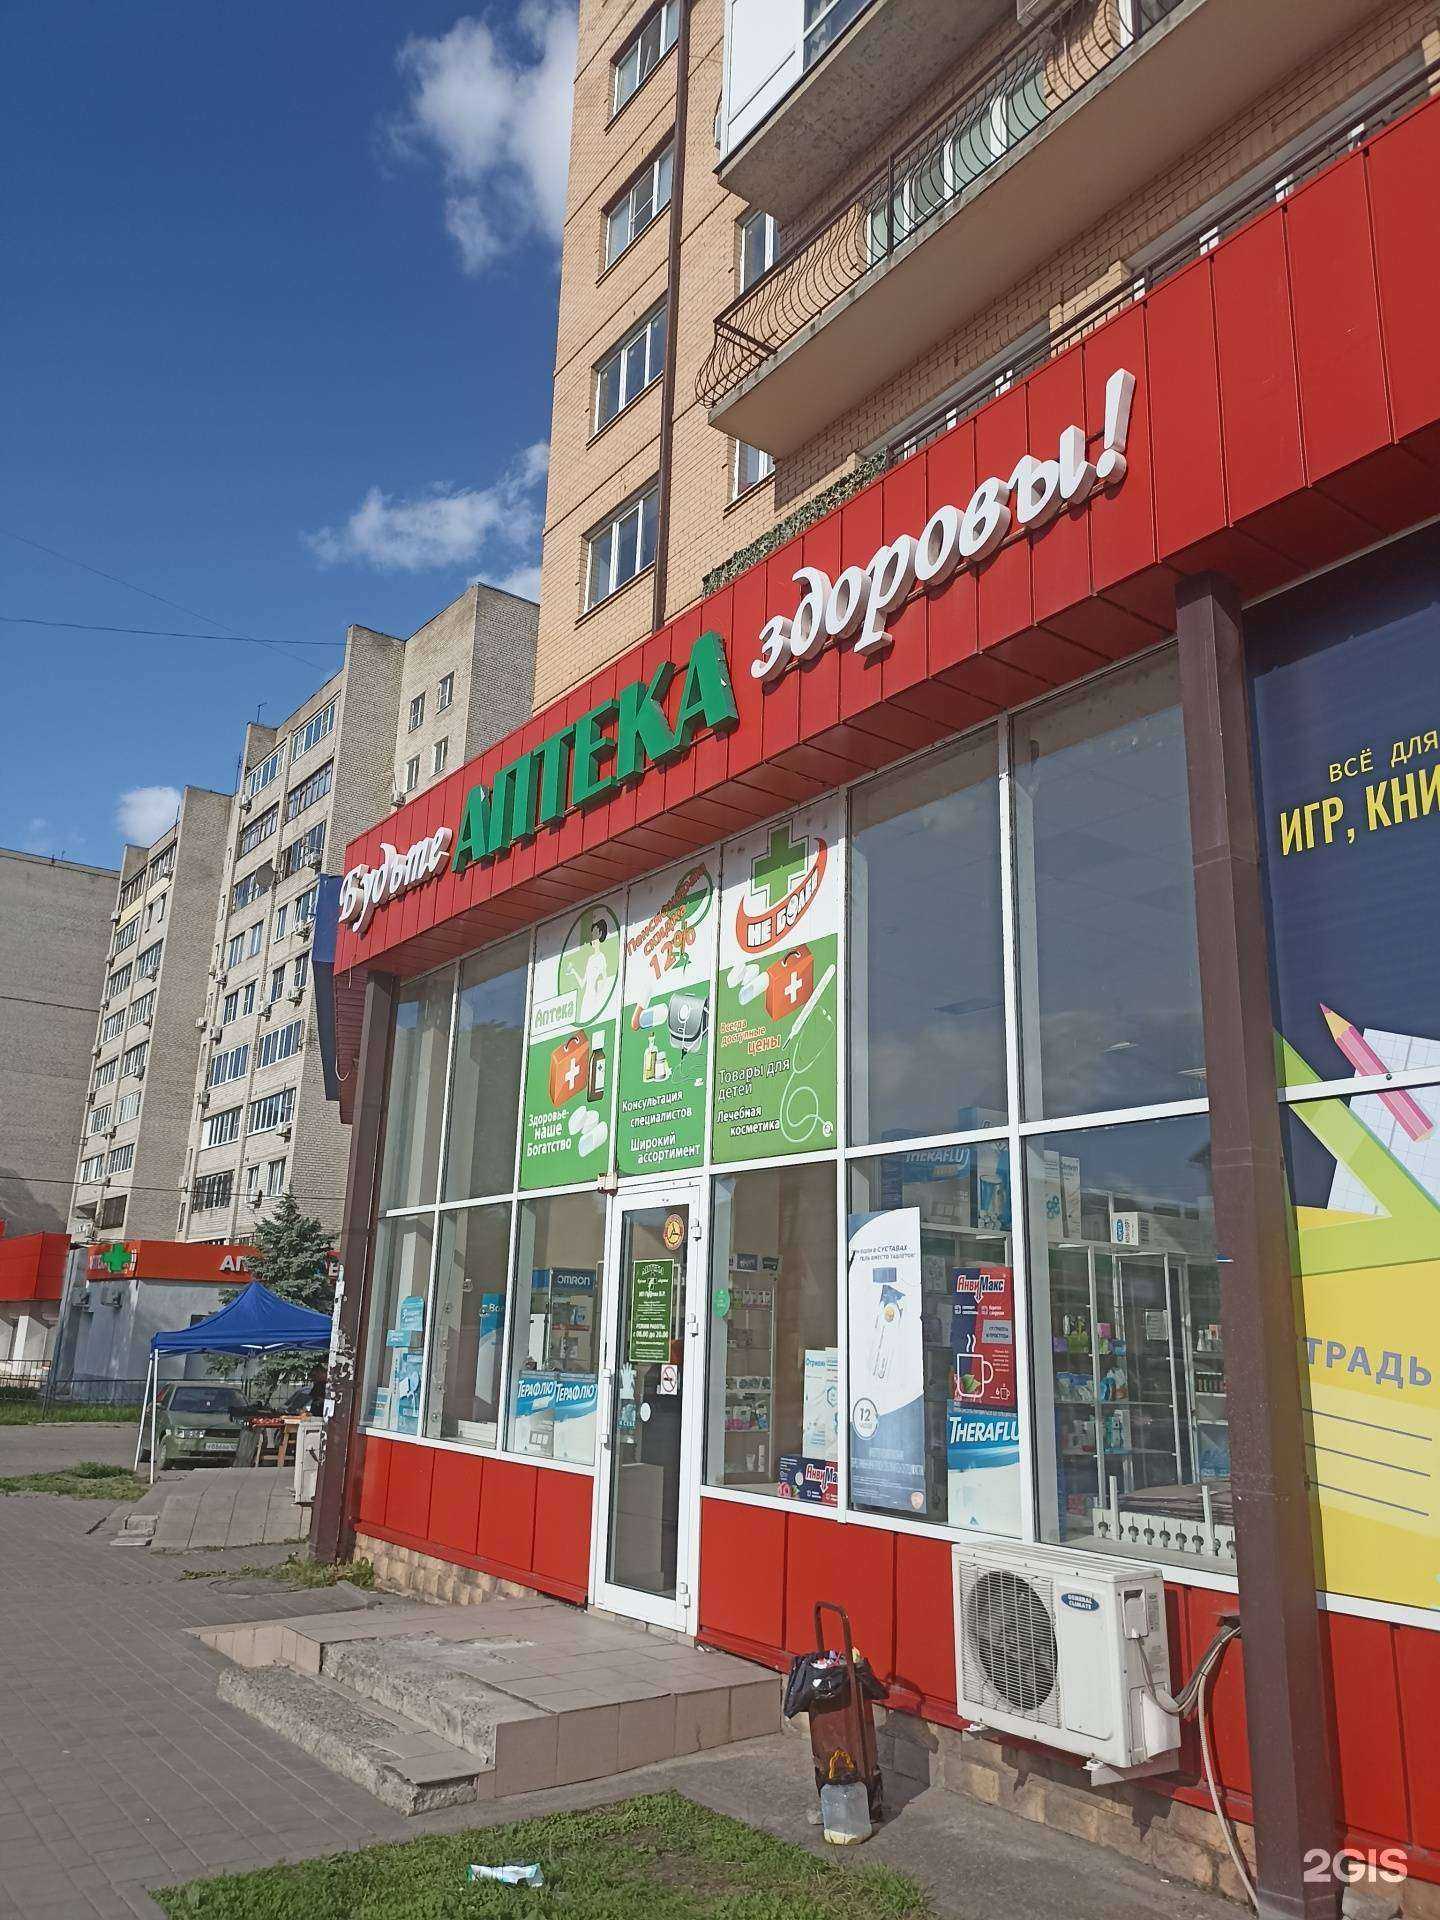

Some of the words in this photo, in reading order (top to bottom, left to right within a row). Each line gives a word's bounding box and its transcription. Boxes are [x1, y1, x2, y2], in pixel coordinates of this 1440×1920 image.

[339, 827, 452, 935] Будьте
[452, 630, 739, 873] АПТЕКА
[750, 368, 1136, 682] здоровы!
[1329, 748, 1374, 783] ВСЁ
[1390, 730, 1439, 768] ДЛЯ
[1280, 796, 1355, 856] ИГР,
[747, 916, 773, 948] НЕ
[534, 1000, 574, 1028] Аптека
[747, 1034, 782, 1056] цены
[720, 1064, 765, 1084] Товары
[766, 1058, 791, 1078] для
[622, 1090, 684, 1112] Консультация
[718, 1082, 753, 1103] детей
[630, 1107, 693, 1128] специалистов
[717, 1106, 762, 1123] Лечебная
[730, 1119, 780, 1137] косметика
[526, 1137, 572, 1157] Богатство
[630, 1130, 677, 1152] Широкий
[637, 1144, 701, 1165] ассортимент
[949, 1416, 1020, 1444] THERAFLU
[1067, 1594, 1093, 1604] GENERAL
